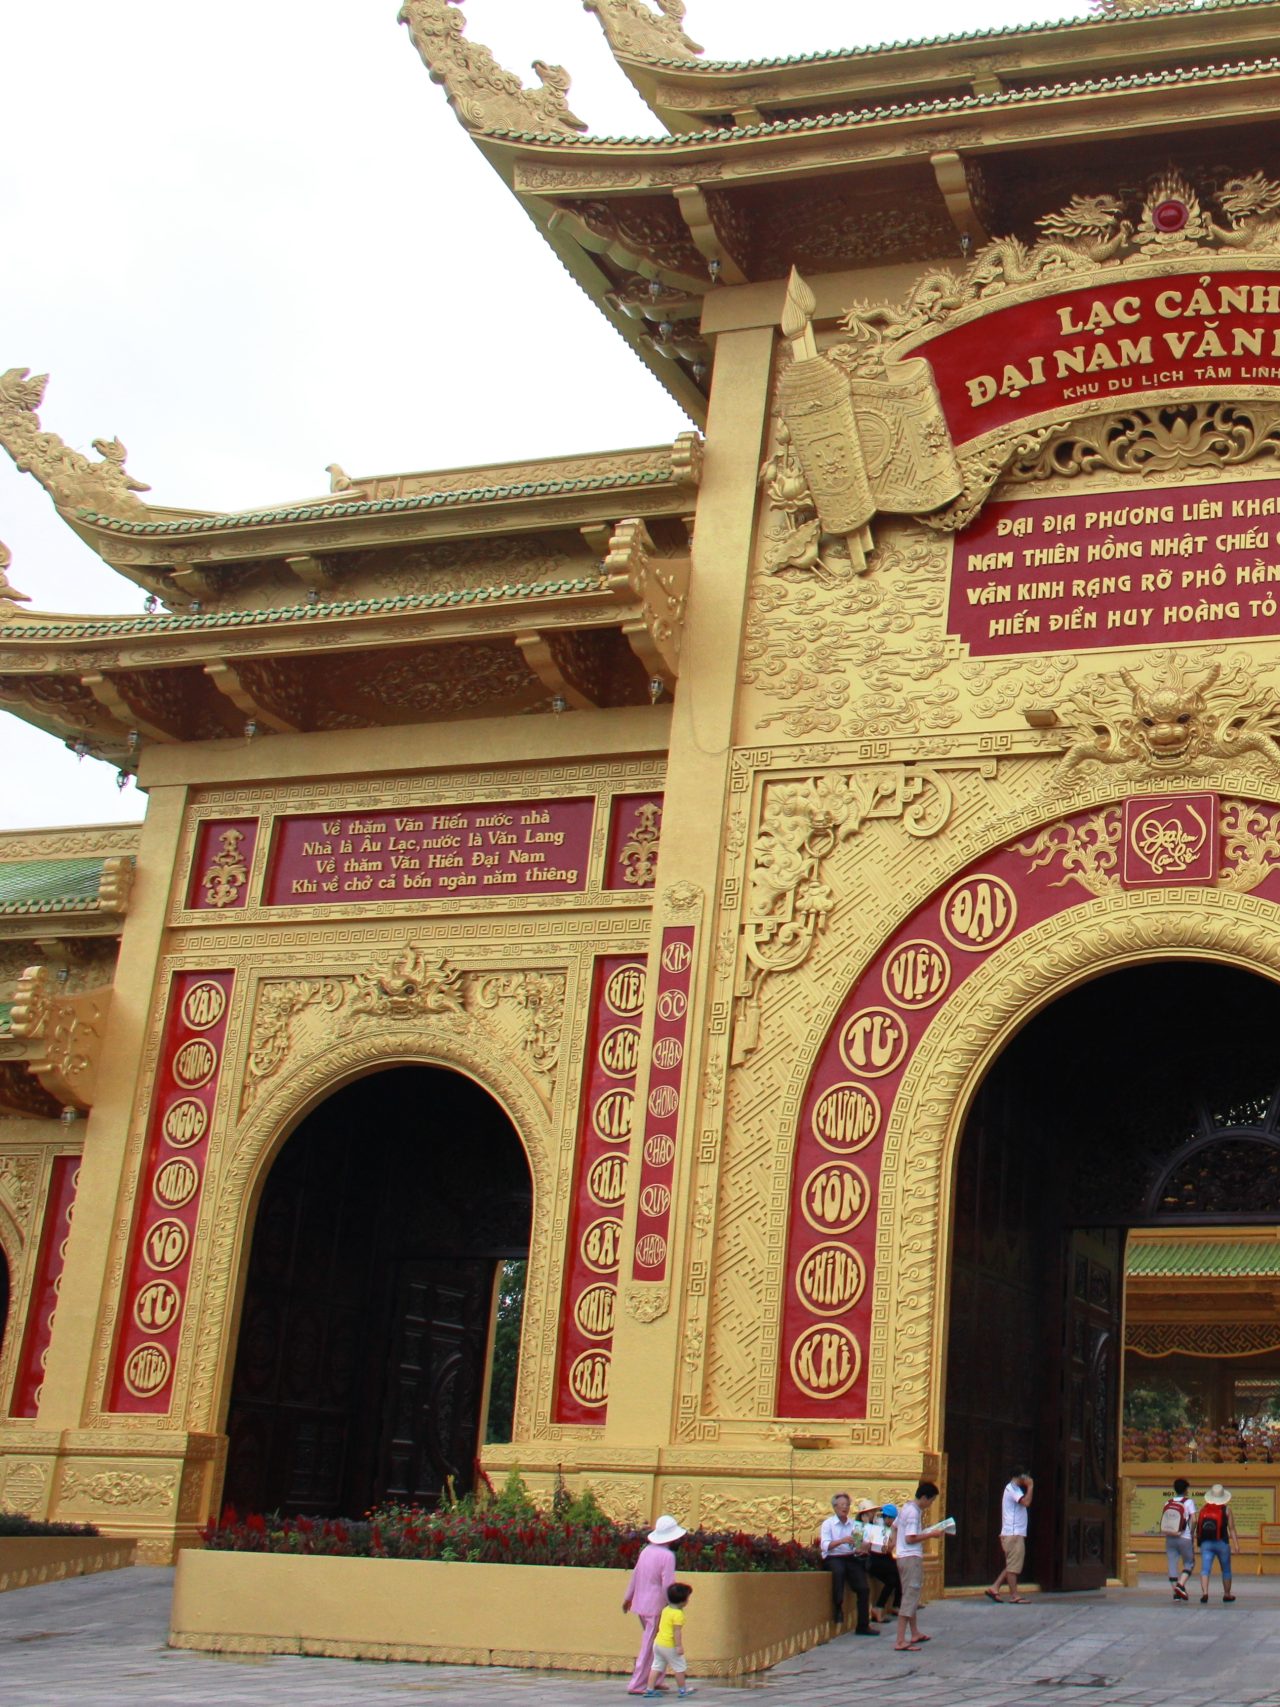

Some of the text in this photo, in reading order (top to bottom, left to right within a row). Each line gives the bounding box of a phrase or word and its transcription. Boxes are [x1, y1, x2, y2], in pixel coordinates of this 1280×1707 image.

[1056, 296, 1141, 335] LẠC
[965, 357, 1045, 407] ĐẠI
[1053, 336, 1154, 378] NAM
[1162, 321, 1265, 359] VĂN
[1063, 382, 1099, 399] KHU
[1108, 377, 1132, 390] DU
[1142, 370, 1183, 386] LỊCH
[1194, 365, 1231, 379] TÂM
[996, 517, 1033, 537] ĐẠI
[1042, 514, 1075, 534] ĐỊA
[1085, 506, 1174, 529] PHƯƠNG
[1183, 499, 1223, 521] LIÊN
[968, 551, 1014, 572] NAM
[1022, 543, 1079, 567] THIÊN
[1088, 534, 1142, 563] HỒNG
[1150, 533, 1208, 557] NHẬT
[1216, 526, 1268, 553] CHIẾU
[966, 582, 1011, 605] VĂN
[1017, 581, 1064, 600] KINH
[1072, 575, 1131, 598] RẠNG
[1141, 569, 1173, 592] RỠ
[1182, 563, 1227, 588] PHÔ
[989, 609, 1040, 638] HIẾN
[1048, 606, 1097, 631] ĐIỂN
[1107, 608, 1154, 629] HUY
[1164, 599, 1240, 625] HOÀNG
[1249, 591, 1277, 617] TỎ
[321, 809, 550, 835] Về thăm Văn Hiến nước nhà
[302, 829, 565, 855] Nhà là Âu Lạc, nước là Văn Lang
[316, 849, 545, 873] Về thăm Văn Hiến Đại Nam
[292, 867, 578, 893] Khi về chở cả bốn ngàn năm thiêng
[663, 943, 690, 971] KIM
[188, 987, 221, 1023] VĂN
[179, 1044, 211, 1080] PHONG
[168, 1104, 203, 1142] NGỌC
[798, 883, 1007, 1388] ĐẠI VIỆT TỨ PHƯƠNG TÔN CHÍNH KHÍ
[151, 1225, 182, 1263] VÔ
[140, 1286, 175, 1325] TƯ
[130, 1349, 165, 1389] CHIẾU
